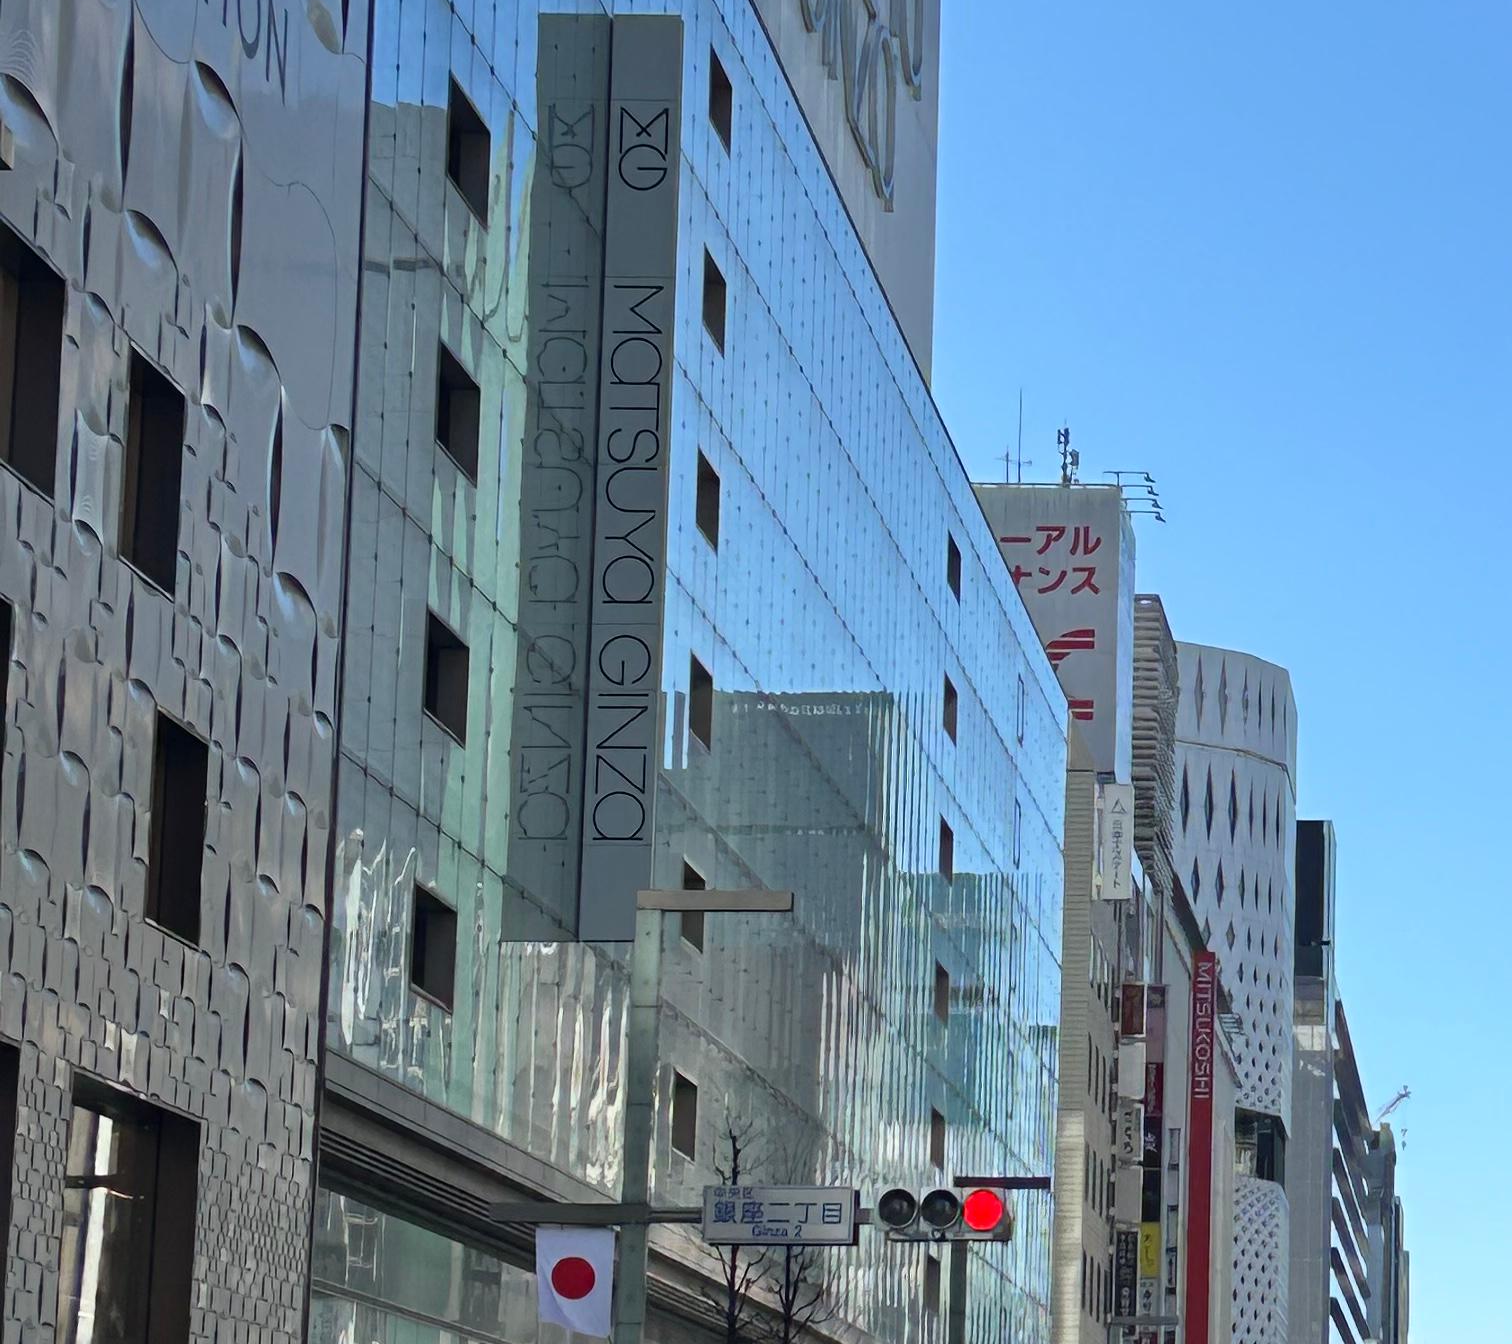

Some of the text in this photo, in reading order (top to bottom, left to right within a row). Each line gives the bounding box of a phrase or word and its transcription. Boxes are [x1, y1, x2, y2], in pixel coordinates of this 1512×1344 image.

[1193, 961, 1214, 1099] MITSUKOSHI
[712, 1201, 843, 1224] 銀座二丁目
[751, 1224, 803, 1238] Ginza 2
